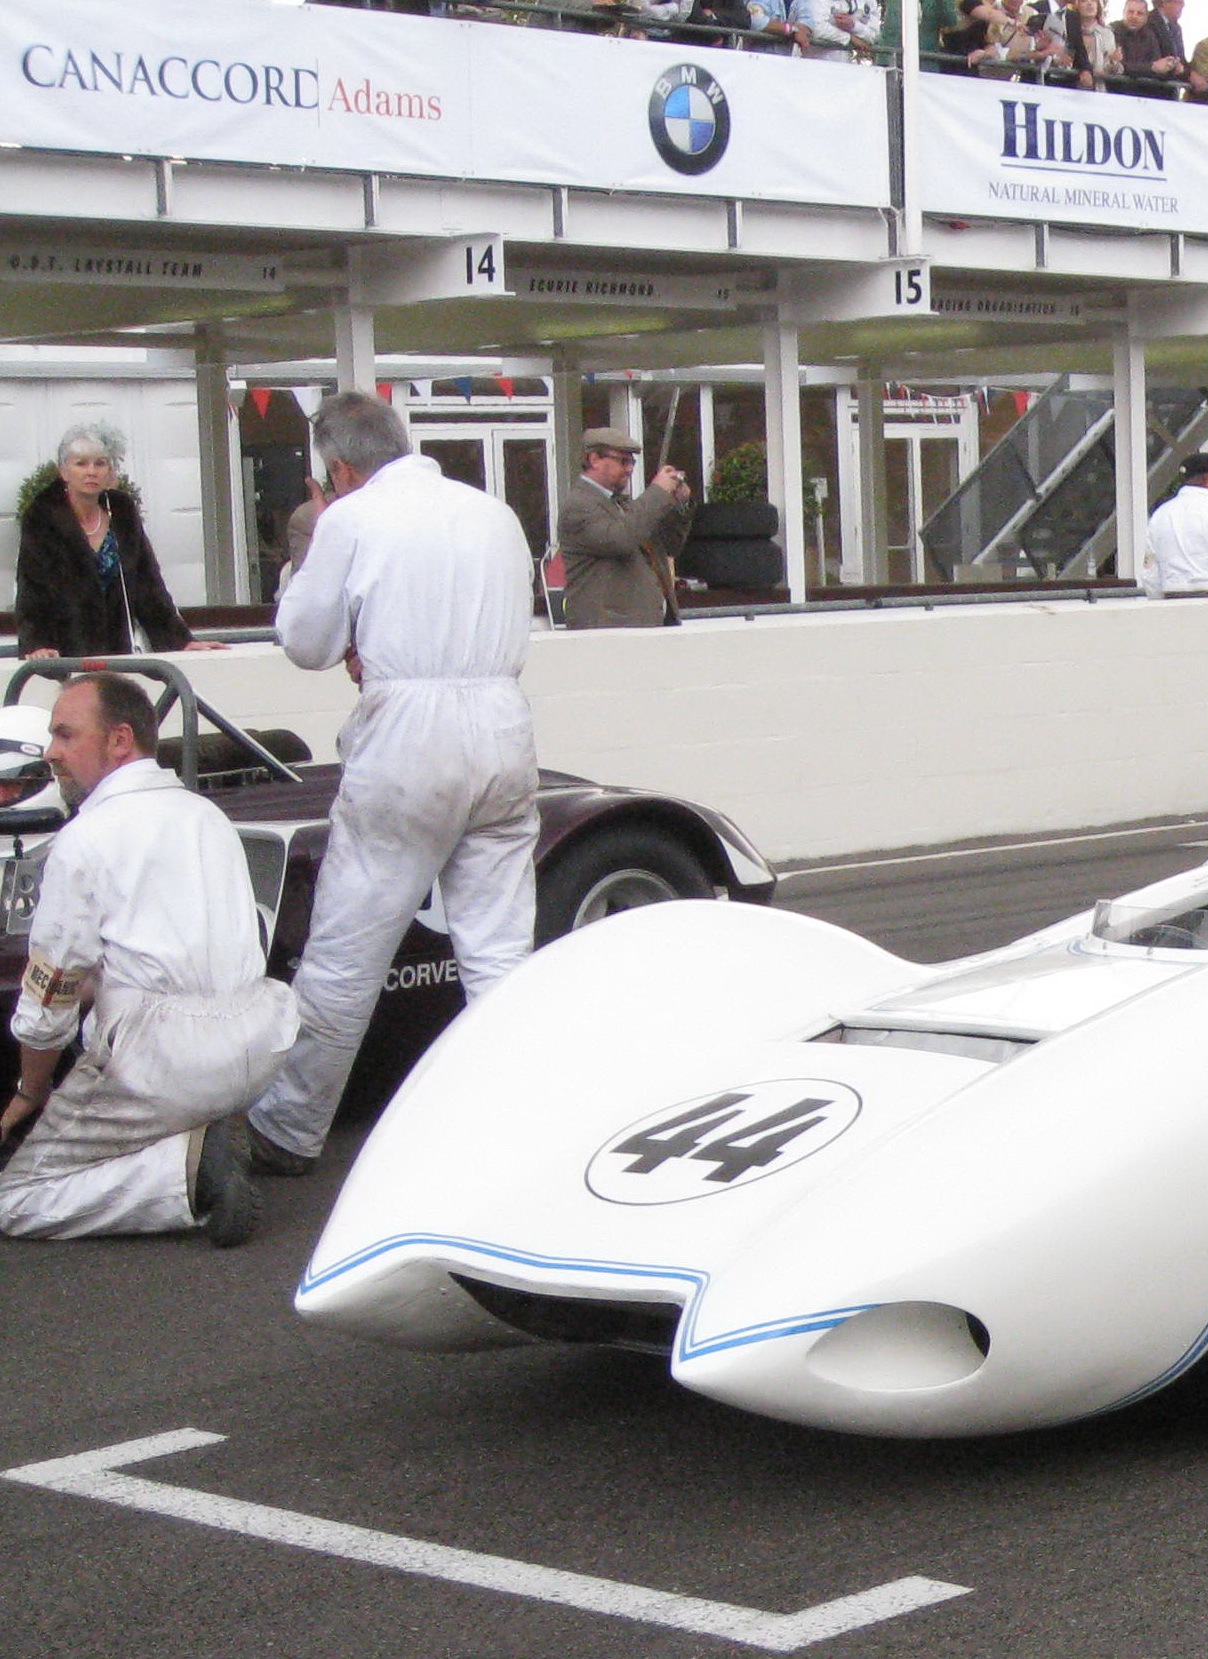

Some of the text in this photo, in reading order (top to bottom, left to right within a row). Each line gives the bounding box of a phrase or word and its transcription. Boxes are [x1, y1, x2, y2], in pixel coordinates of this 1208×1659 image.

[22, 44, 442, 120] CANACCORD Adams
[655, 65, 724, 105] BMW
[989, 181, 1179, 213] NATURAL MINERAL WATER
[466, 245, 496, 284] 14
[895, 269, 922, 306] 15
[609, 1092, 837, 1183] 44
